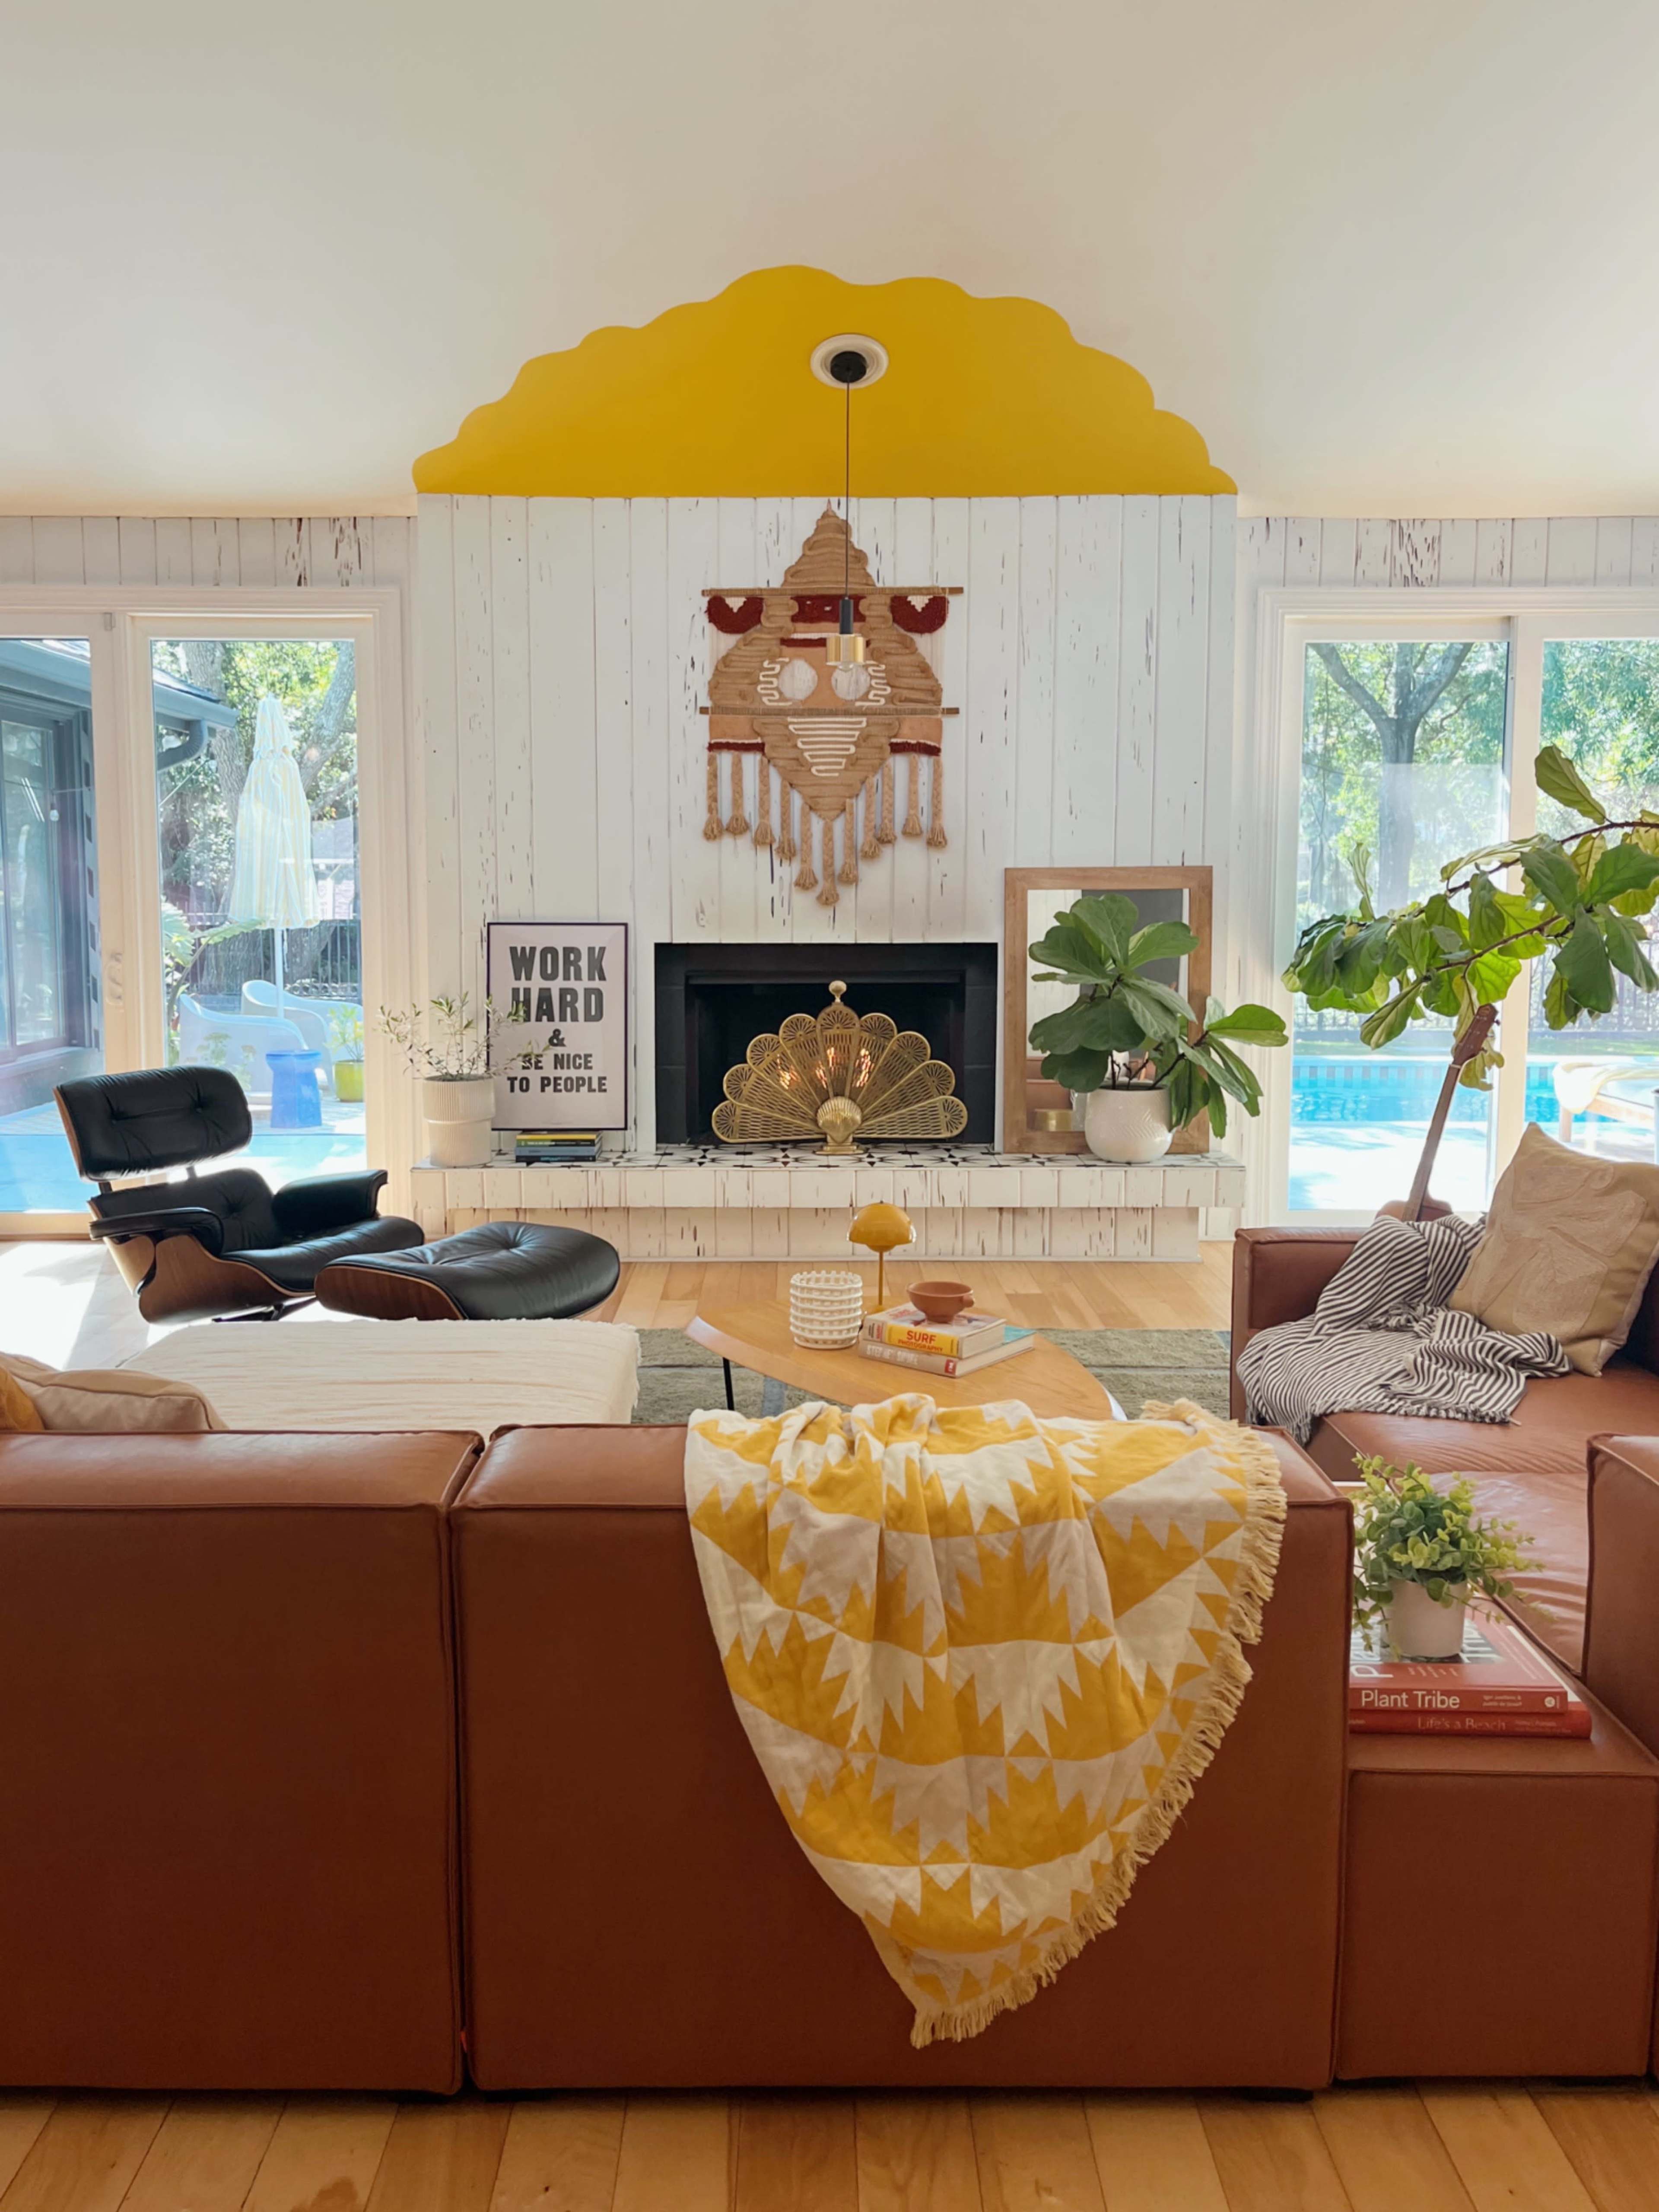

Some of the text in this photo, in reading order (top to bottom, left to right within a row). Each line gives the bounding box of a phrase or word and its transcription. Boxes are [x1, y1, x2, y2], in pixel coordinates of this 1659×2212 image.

[509, 946, 607, 981] WORK
[510, 987, 604, 1022] HARD
[548, 1028, 566, 1047] &
[521, 1053, 593, 1070] BE NICE
[507, 1076, 607, 1093] TO PEOPLE
[897, 1339, 944, 1352] PHOTOGRAPHY
[906, 1330, 937, 1345] SURF
[1361, 1689, 1460, 1708] Plant Tribe
[1417, 1716, 1450, 1729] Life's
[1465, 1718, 1506, 1731] Beach
